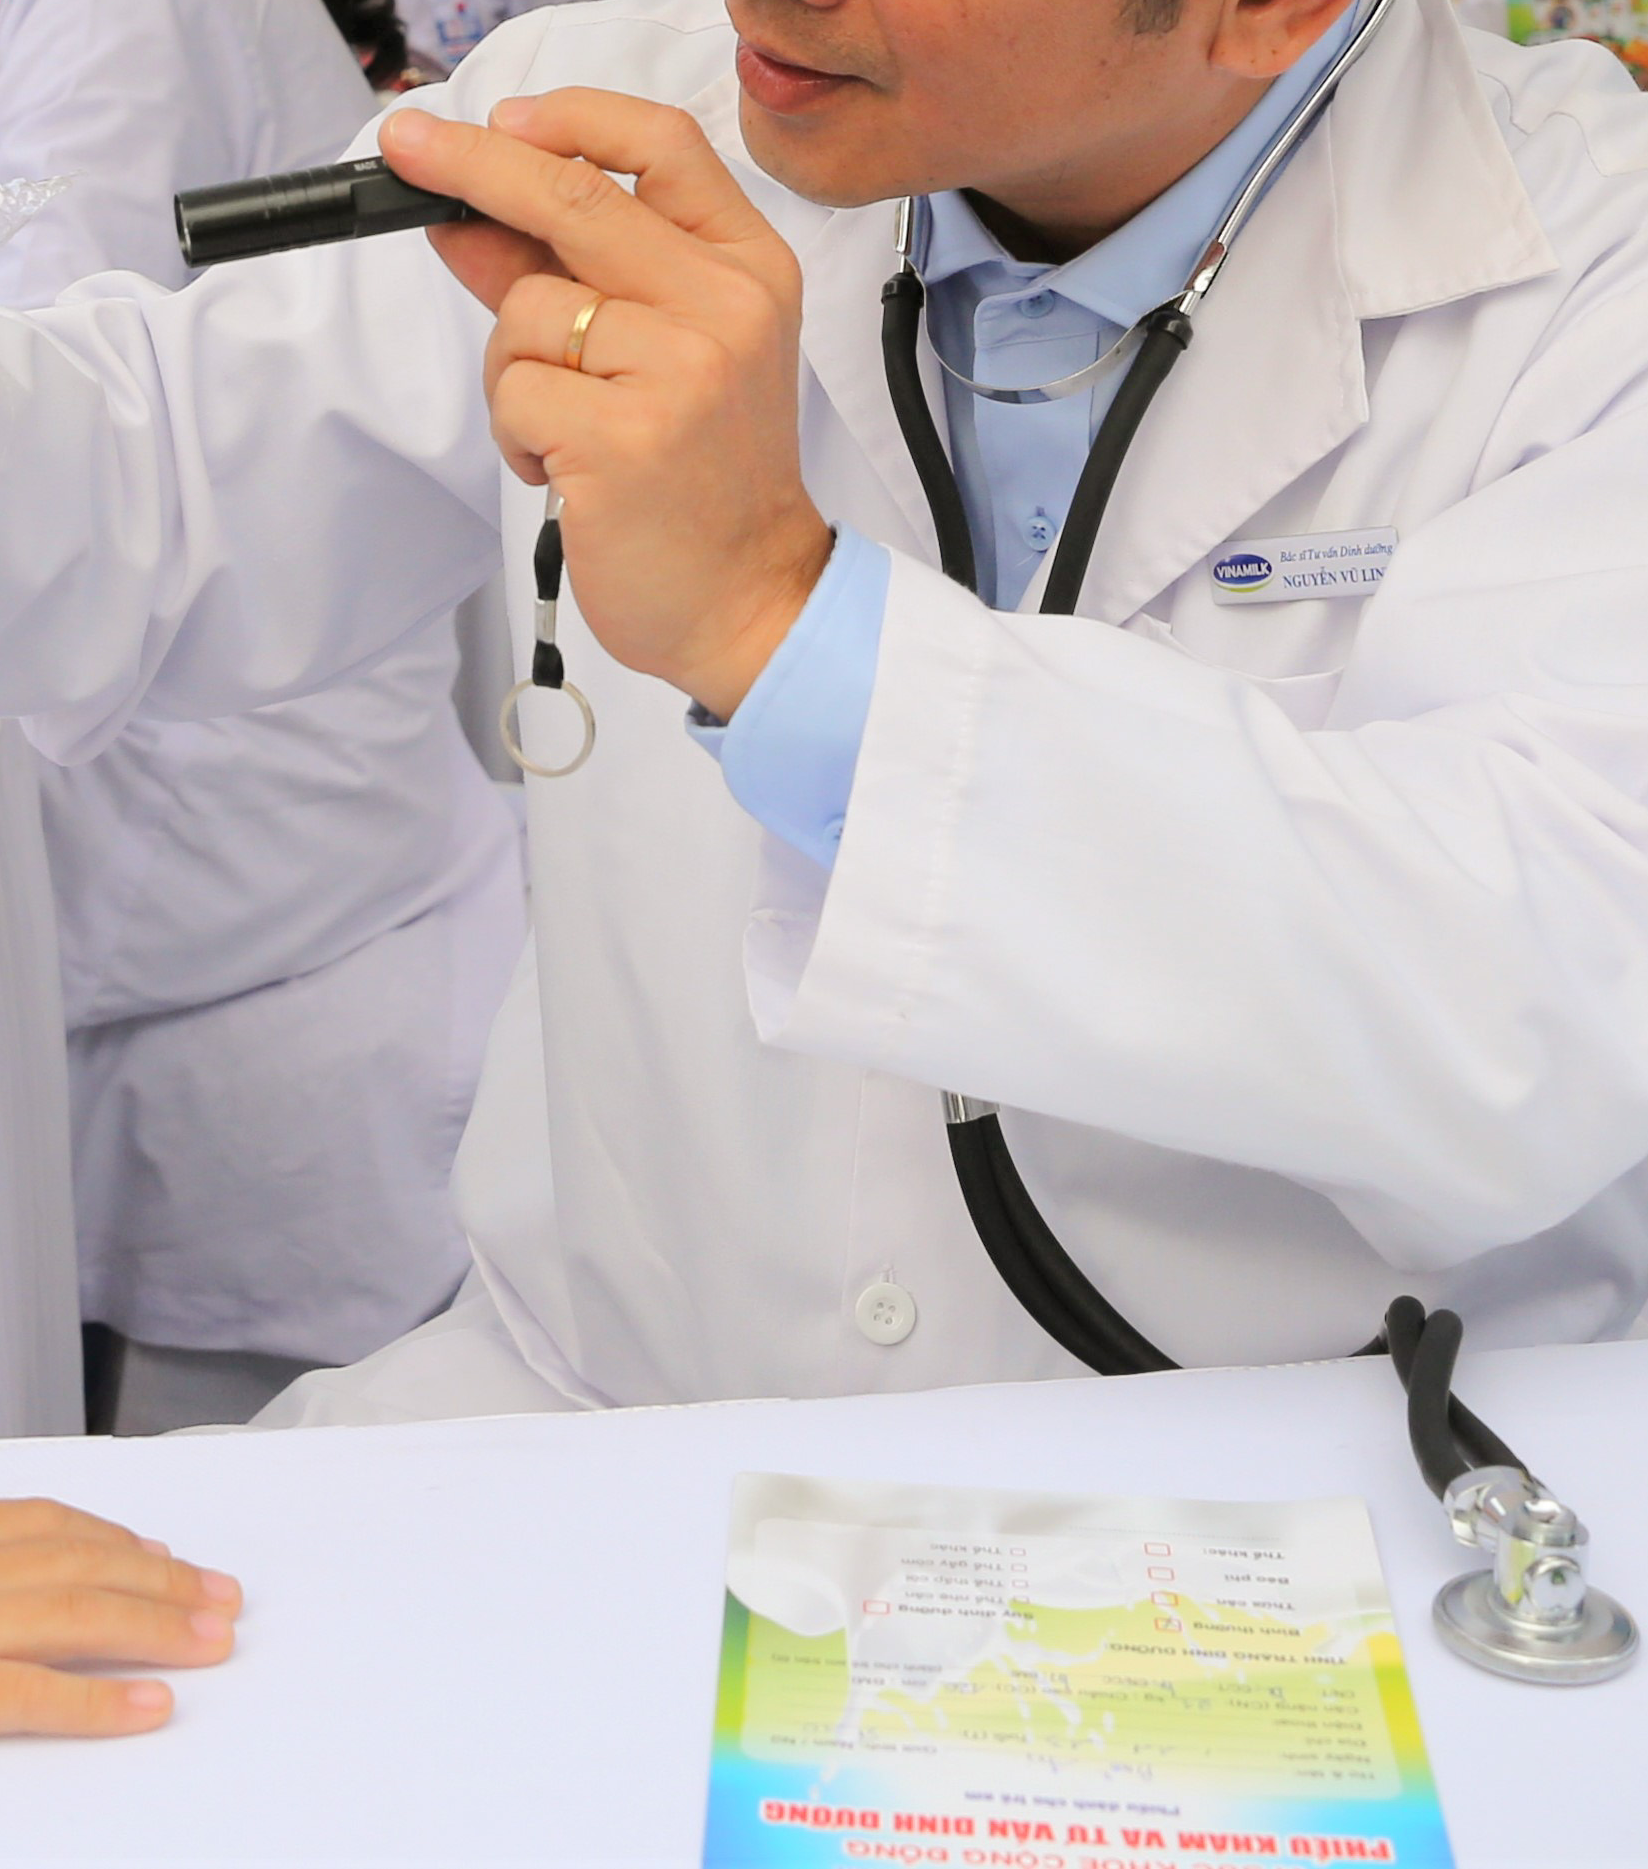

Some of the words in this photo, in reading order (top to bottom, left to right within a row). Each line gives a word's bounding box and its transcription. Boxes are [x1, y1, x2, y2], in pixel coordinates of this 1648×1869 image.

[1279, 550, 1297, 563] Bác
[1340, 544, 1362, 558] Dinh
[1215, 563, 1271, 579] VINAMILK
[1362, 567, 1387, 583] LIN
[893, 1812, 976, 1837] DINH
[1289, 1834, 1393, 1863] PHIẾU
